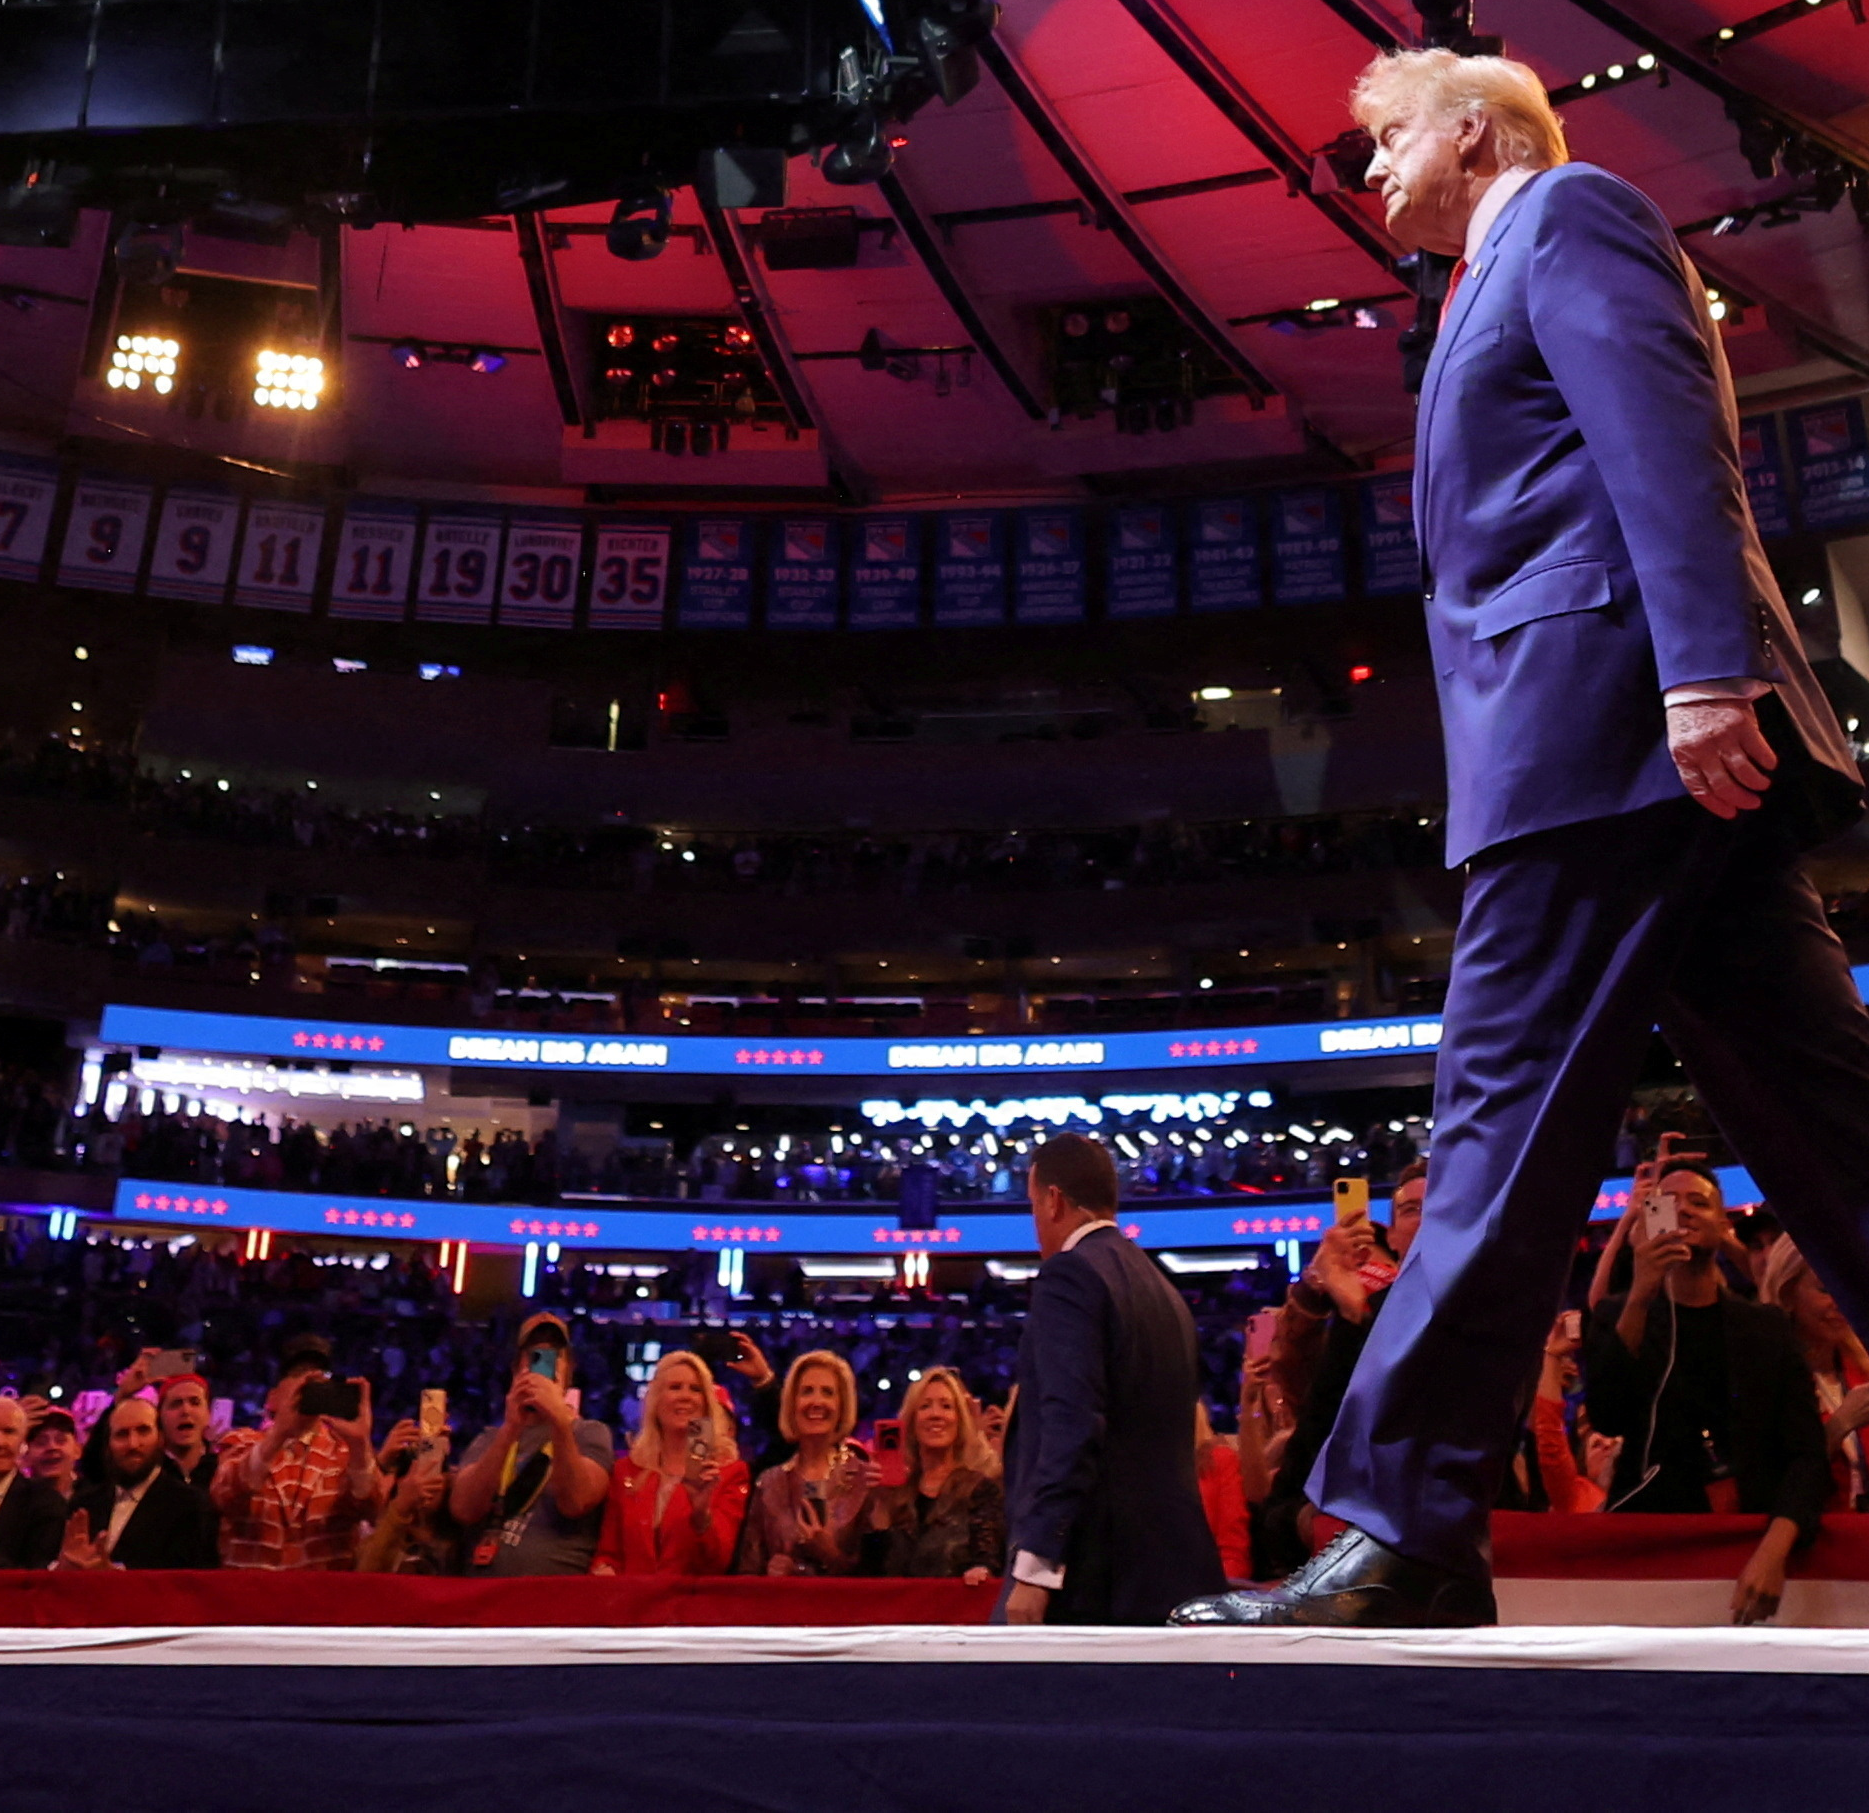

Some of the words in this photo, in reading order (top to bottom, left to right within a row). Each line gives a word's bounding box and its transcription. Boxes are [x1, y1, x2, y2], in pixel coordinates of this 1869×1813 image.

[1801, 456, 1866, 483] 2013-14
[85, 514, 123, 564] 9
[175, 525, 212, 574] 9
[253, 532, 301, 587] 11
[347, 544, 394, 596] 11
[428, 548, 488, 597] 19
[508, 553, 573, 603] 30
[687, 567, 750, 581] 1927-28
[773, 567, 835, 582] 1932-33
[855, 567, 917, 582] 1939-40
[598, 556, 661, 604] 35
[449, 1037, 539, 1062] DREAM
[540, 1041, 585, 1063] BIG
[586, 1042, 668, 1066] AGAIN
[888, 1045, 977, 1067] DREAM
[978, 1044, 1023, 1066] BIG
[1023, 1042, 1105, 1066] AGAIN
[1320, 1025, 1410, 1052] DREAM
